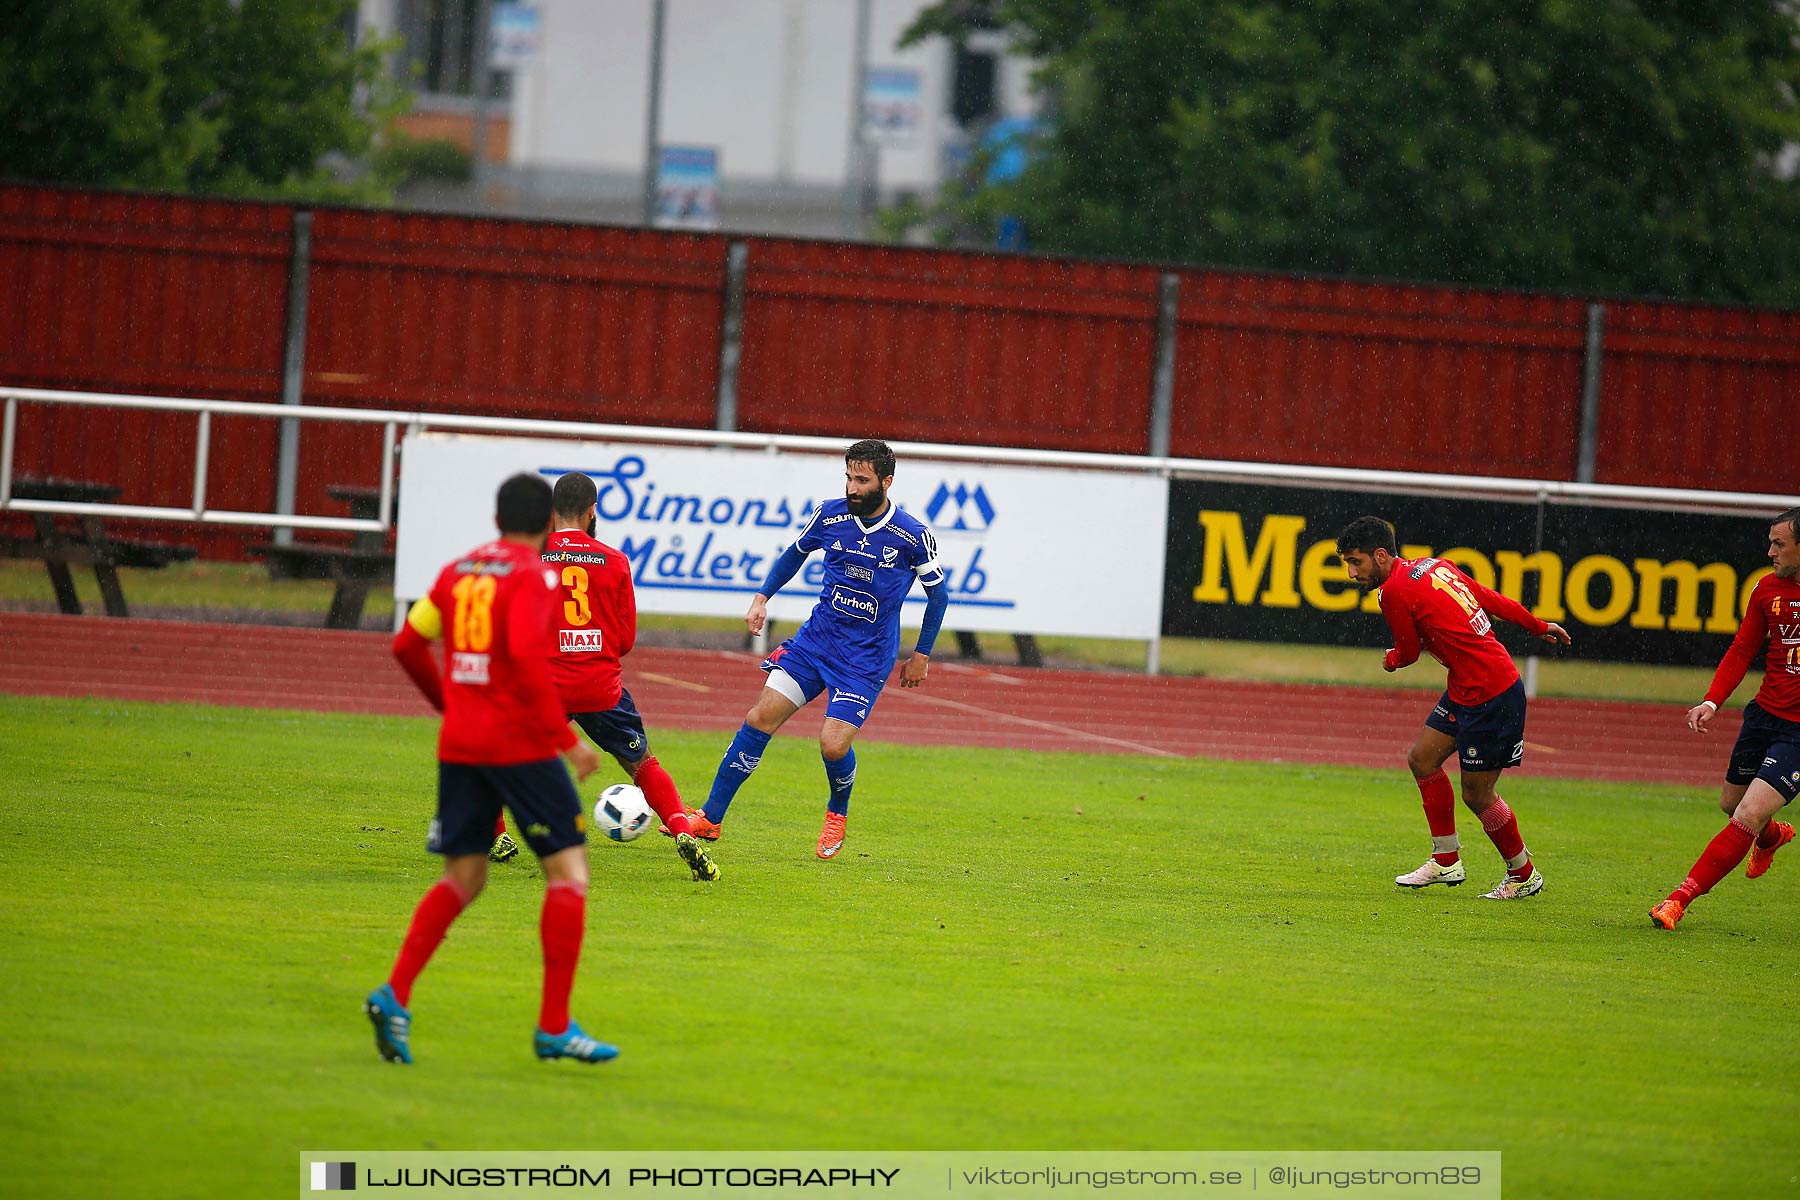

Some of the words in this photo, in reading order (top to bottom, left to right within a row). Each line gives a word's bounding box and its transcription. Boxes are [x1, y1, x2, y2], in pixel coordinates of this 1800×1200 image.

[822, 513, 853, 526] stadium
[561, 566, 591, 626] 3
[834, 592, 875, 614] Furhoffs
[1771, 596, 1781, 615] 4
[560, 632, 601, 646] MAXI
